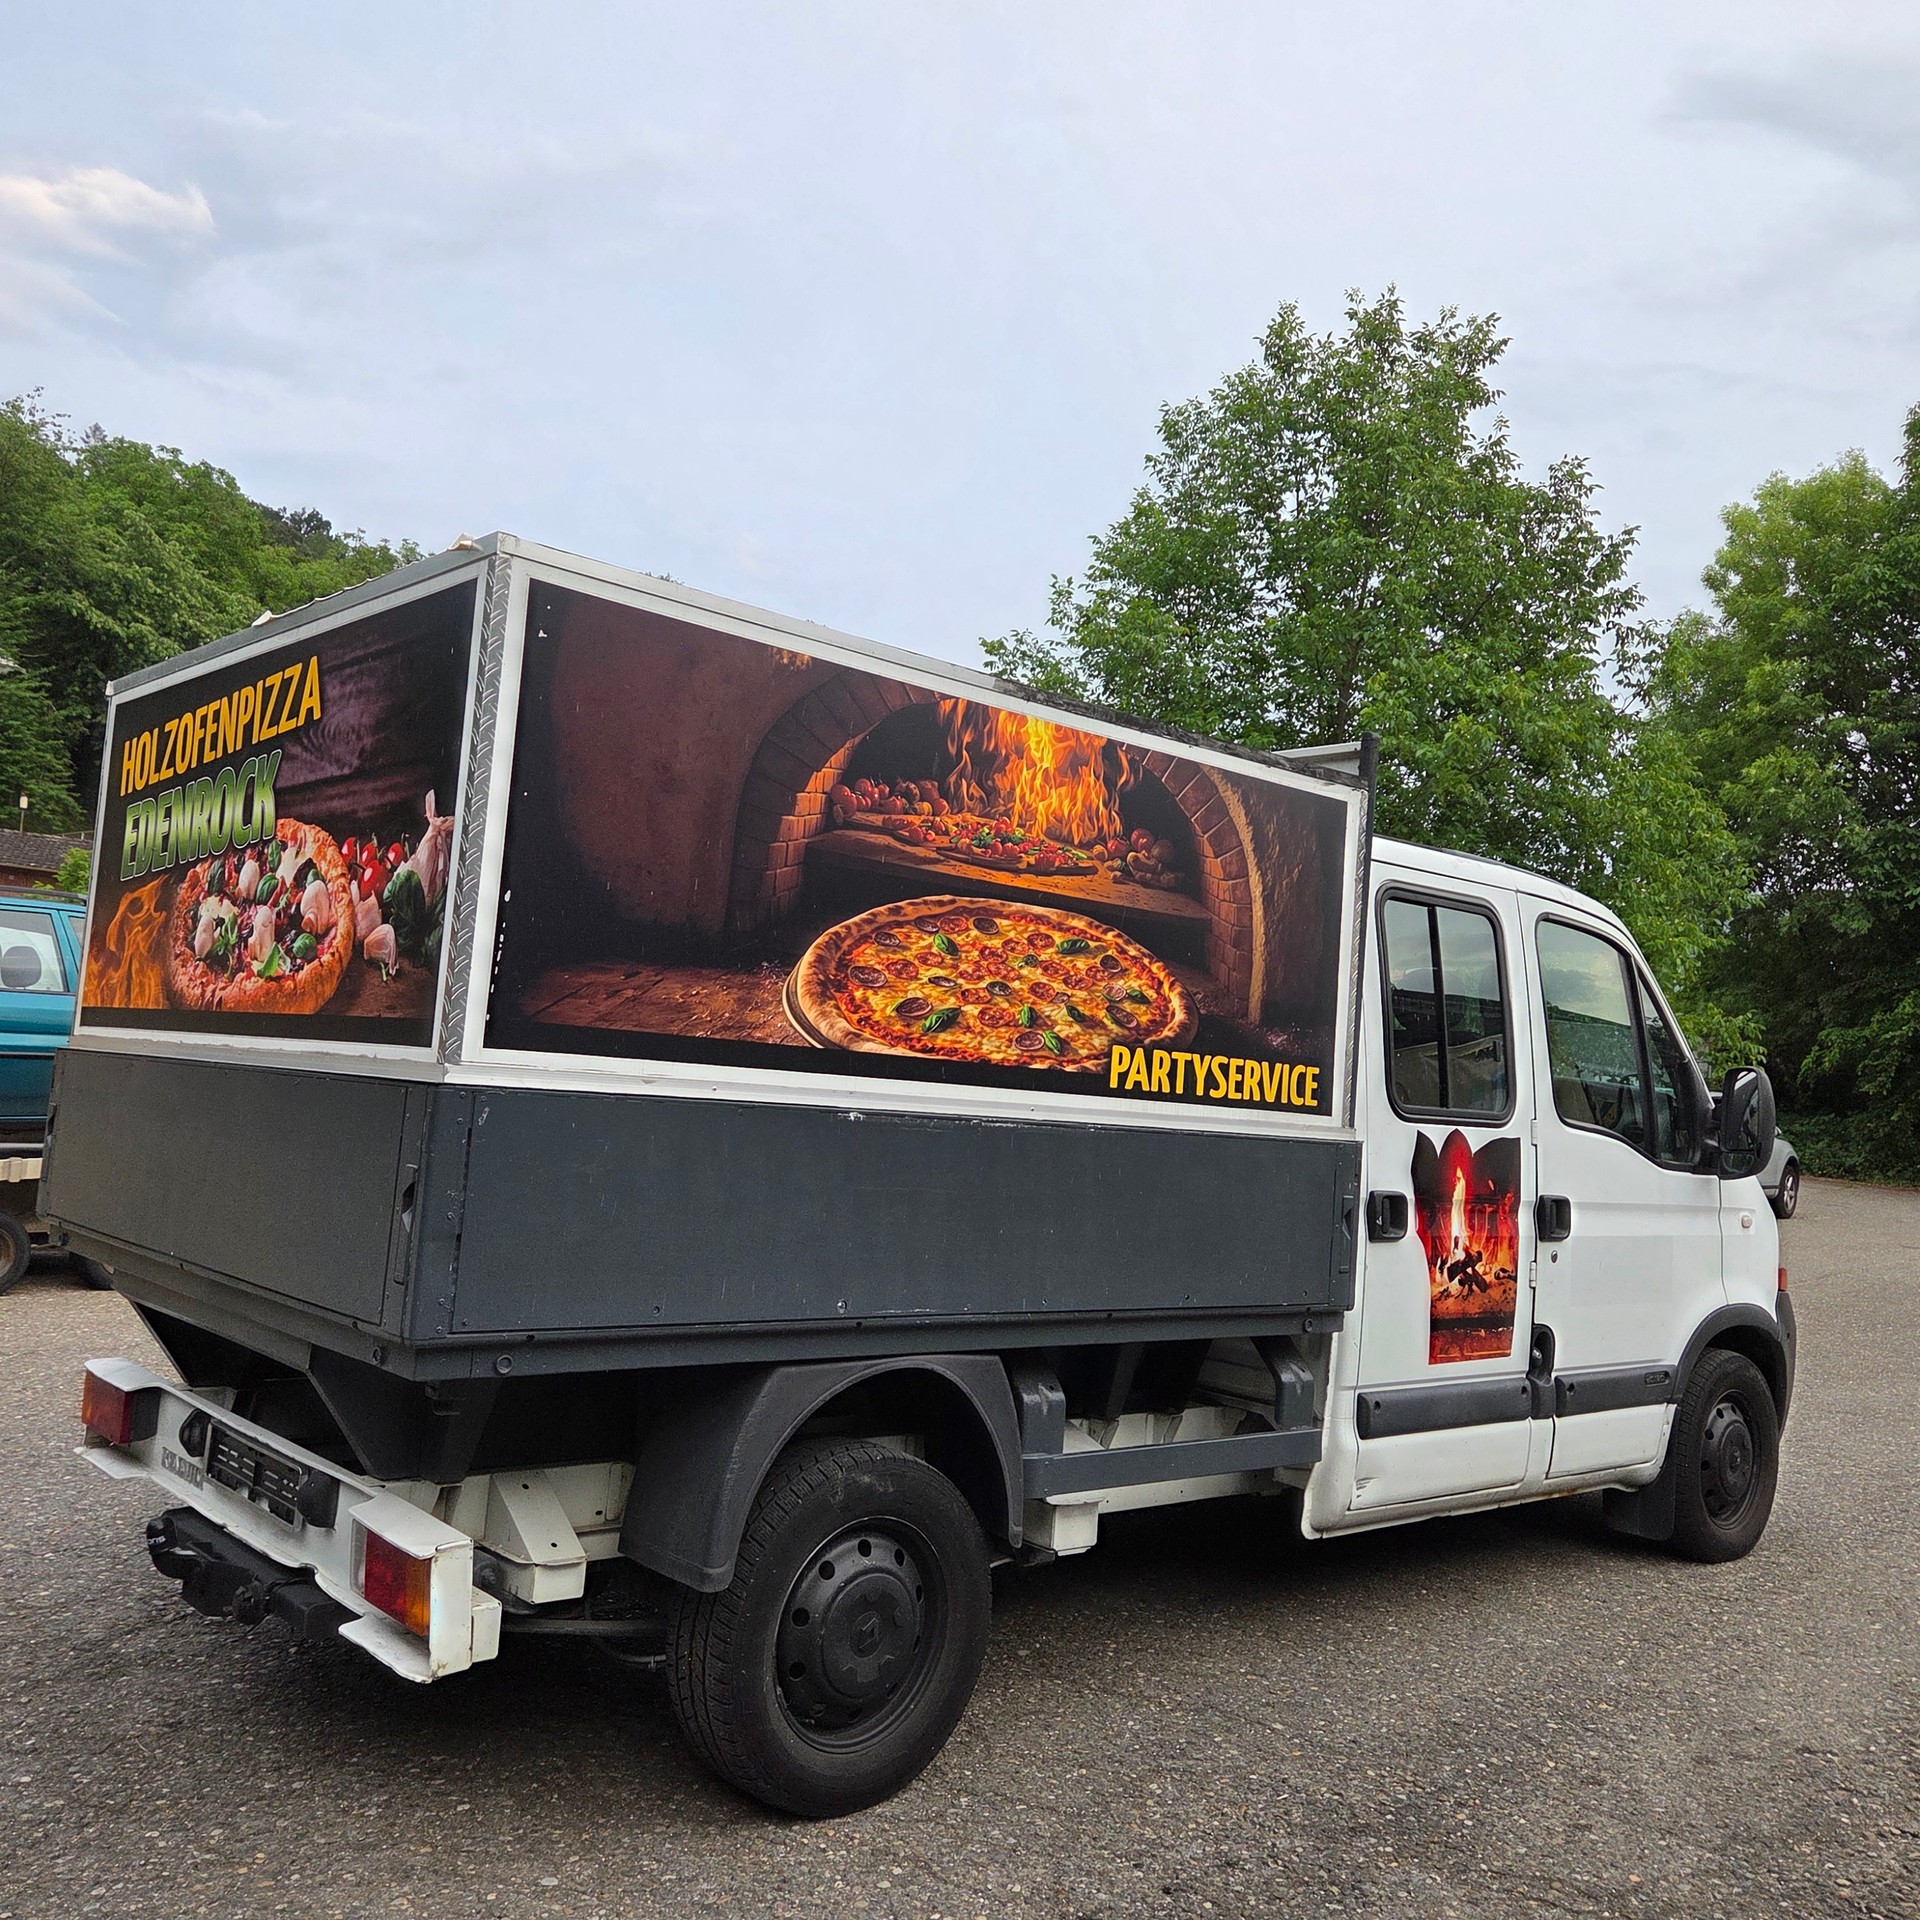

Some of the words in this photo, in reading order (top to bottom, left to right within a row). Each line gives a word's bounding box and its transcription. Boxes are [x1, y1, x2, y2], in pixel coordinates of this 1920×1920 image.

[120, 655, 321, 796] HOLZOFENPIZZA
[120, 750, 282, 881] EDENROCK
[1109, 1044, 1320, 1107] PARTYSERVICE
